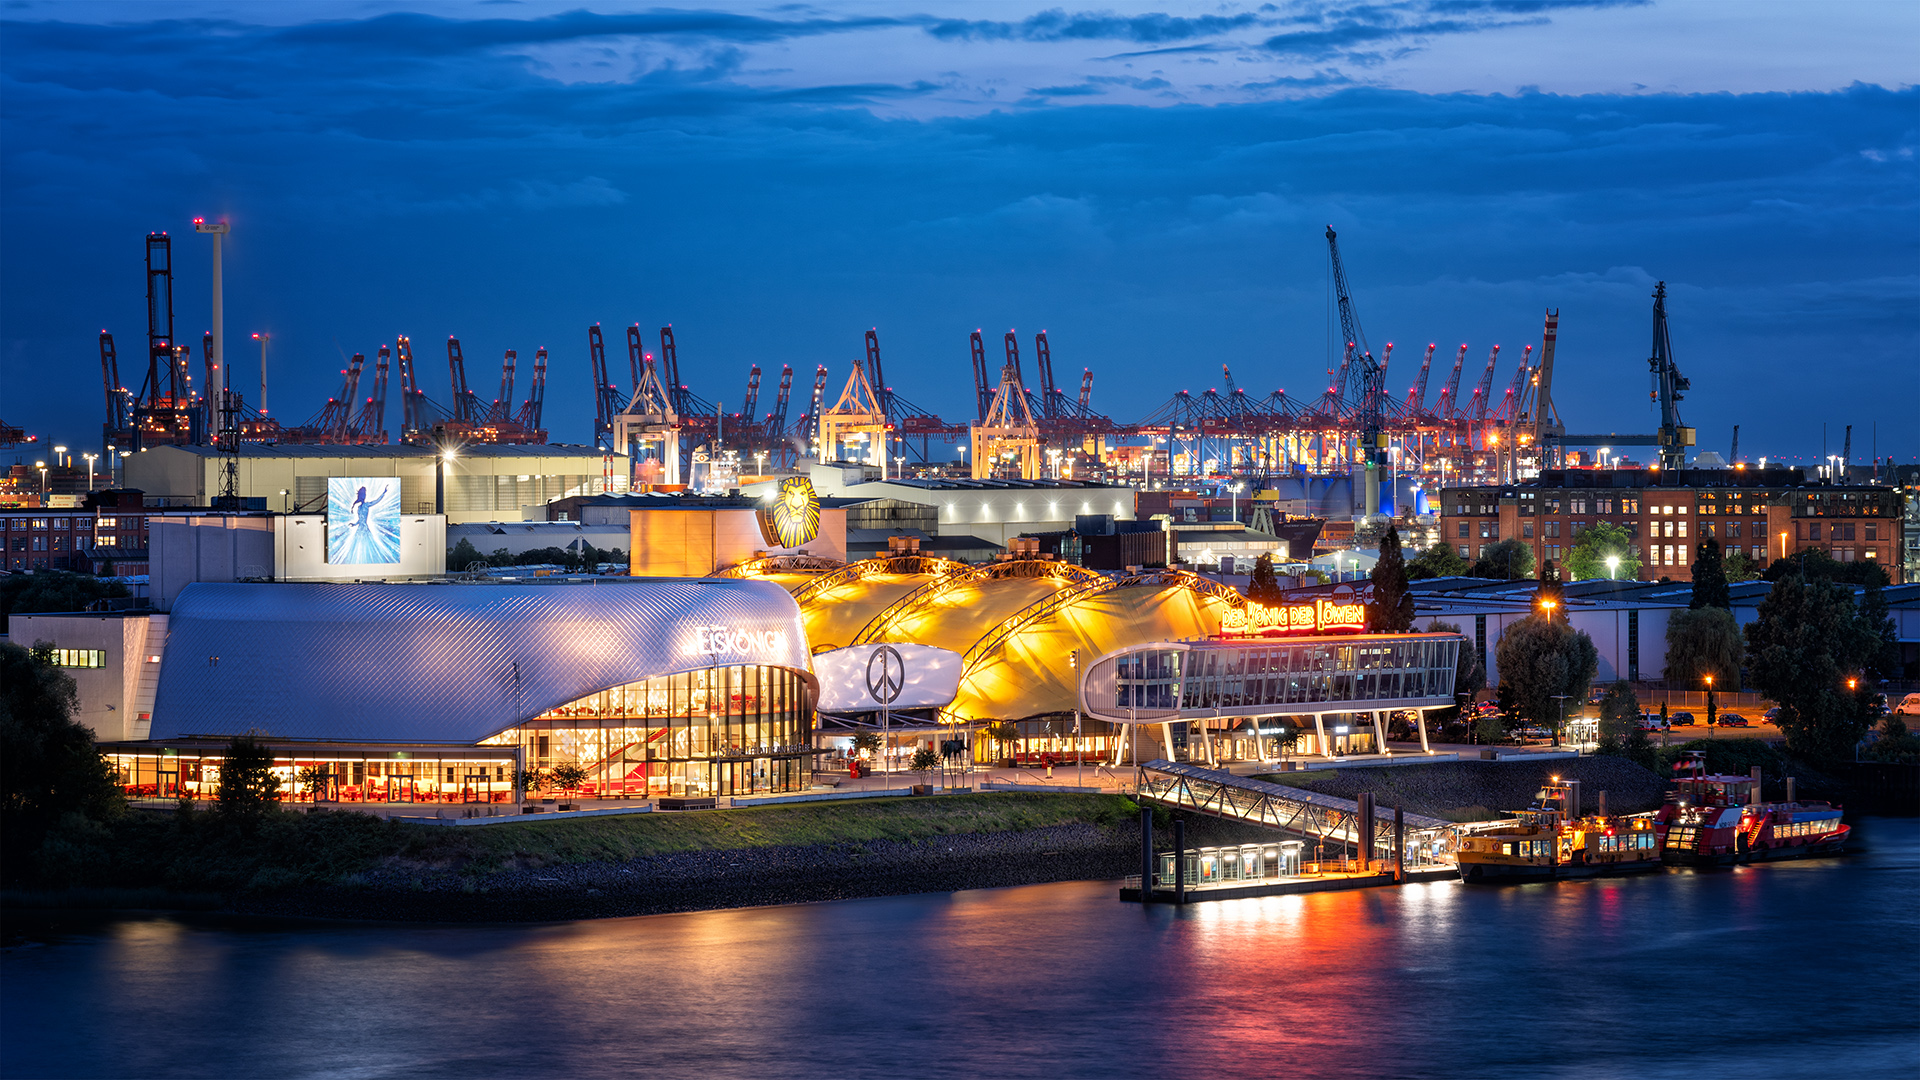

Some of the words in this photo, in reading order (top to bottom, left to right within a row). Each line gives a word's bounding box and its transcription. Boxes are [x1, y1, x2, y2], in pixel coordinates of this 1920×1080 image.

[1222, 608, 1246, 627] DER
[1247, 601, 1288, 633] KÖNIG
[1289, 605, 1314, 625] DER
[1316, 599, 1365, 631] LÖWEN
[719, 744, 744, 757] STAGE
[745, 745, 777, 756] THEATER
[777, 745, 786, 753] AN
[798, 742, 811, 753] ELBE
